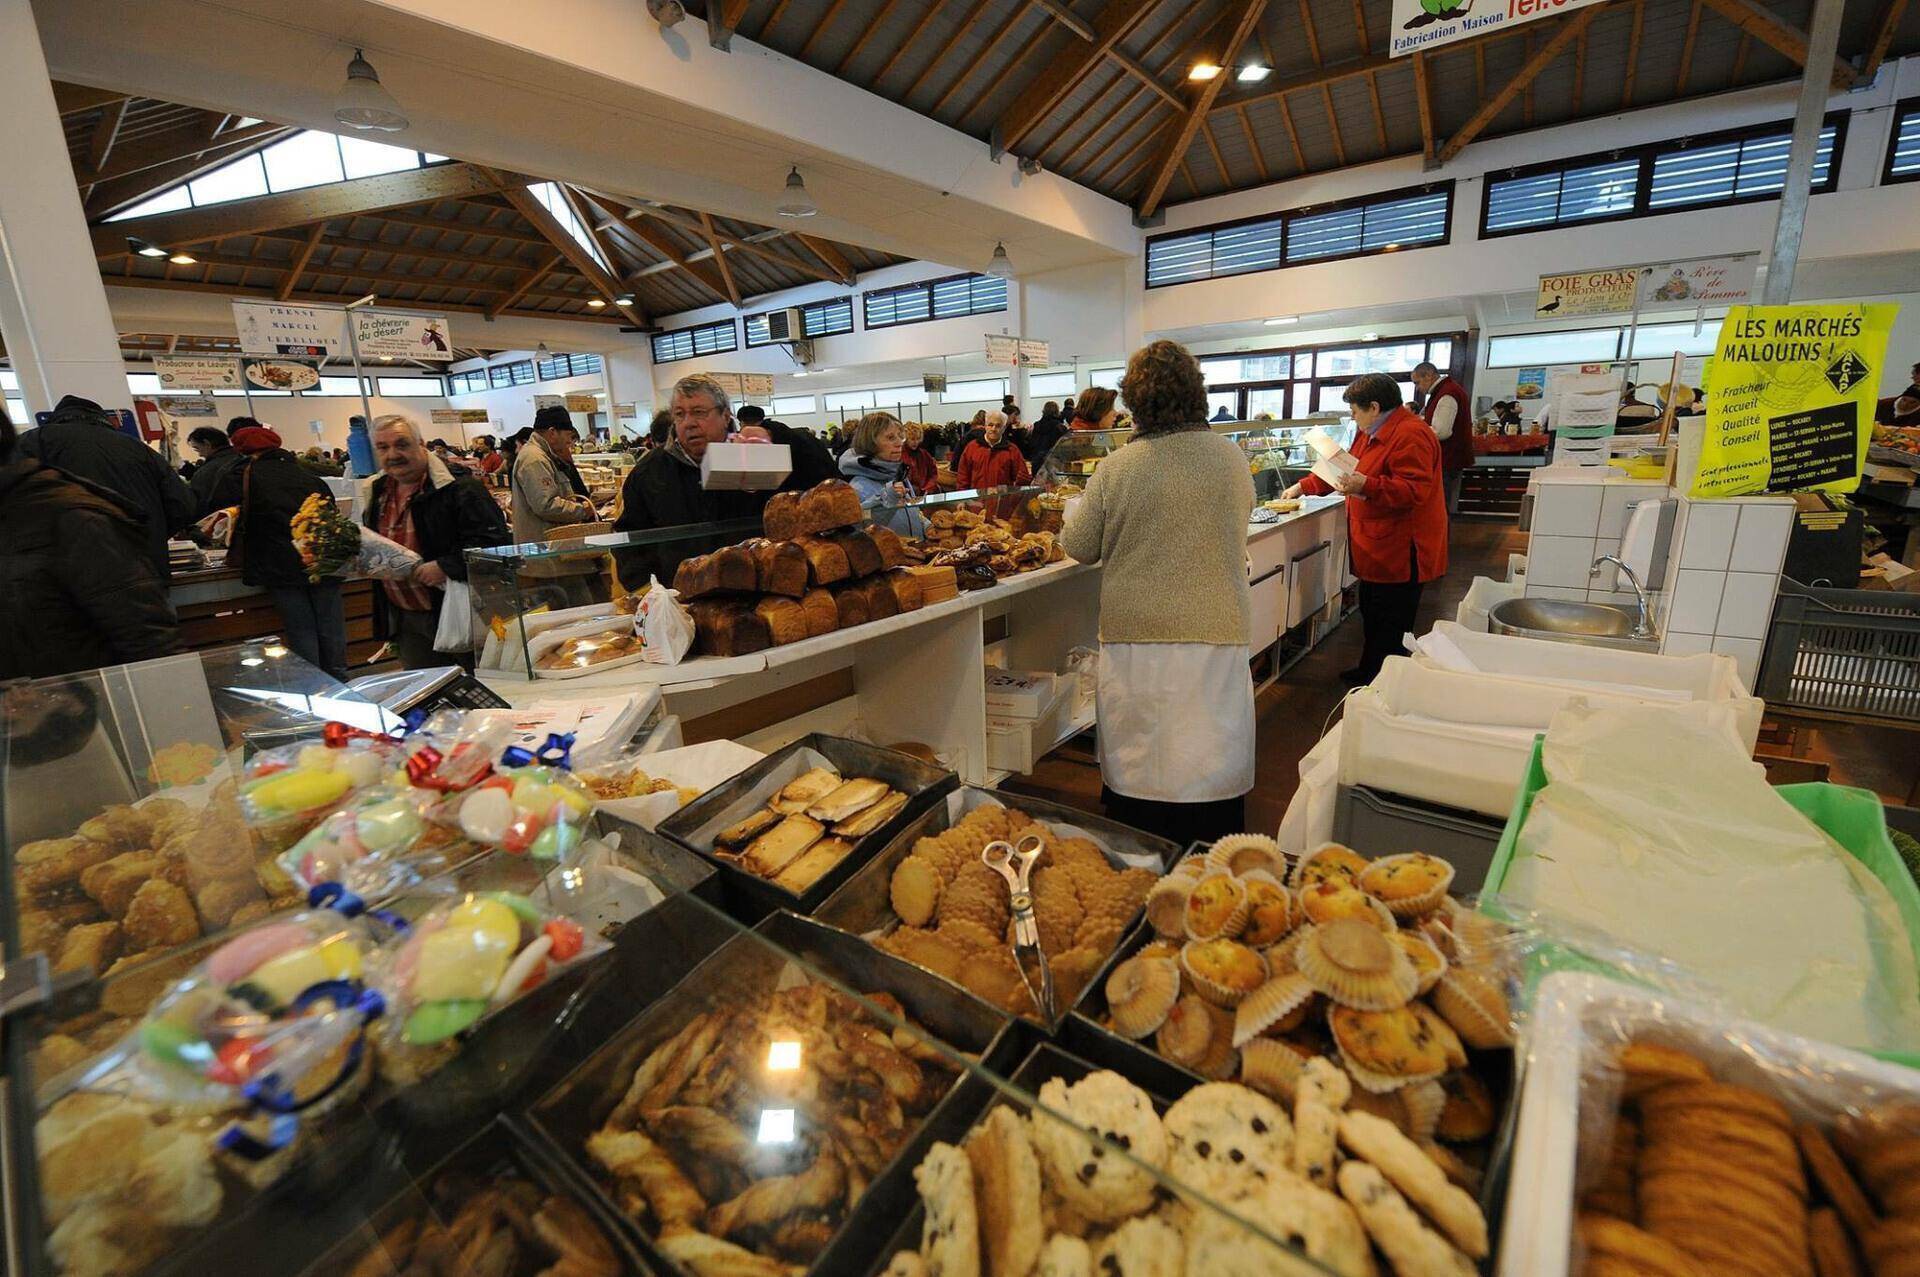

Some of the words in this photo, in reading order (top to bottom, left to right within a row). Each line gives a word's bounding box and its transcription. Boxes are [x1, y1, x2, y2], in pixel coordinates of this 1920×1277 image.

[1394, 26, 1456, 50] Fabrication
[1462, 12, 1503, 31] Maison
[1542, 276, 1582, 293] FOIE
[1589, 270, 1636, 288] GRAS
[1566, 284, 1632, 296] PRODUCTEUR
[272, 321, 319, 331] MARCEL
[360, 320, 369, 331] la
[1735, 319, 1766, 338] LES
[1774, 312, 1863, 338] MARCHÉS
[358, 331, 371, 342] du
[374, 326, 404, 338] désert
[1723, 342, 1822, 362] MALOUINS
[157, 359, 195, 369] Producteur
[1839, 352, 1852, 393] ACAP
[1722, 382, 1772, 398] Fraîcheur
[1721, 398, 1759, 414] Accueil
[1722, 414, 1761, 431] Qualité
[1722, 430, 1761, 447] Conseil
